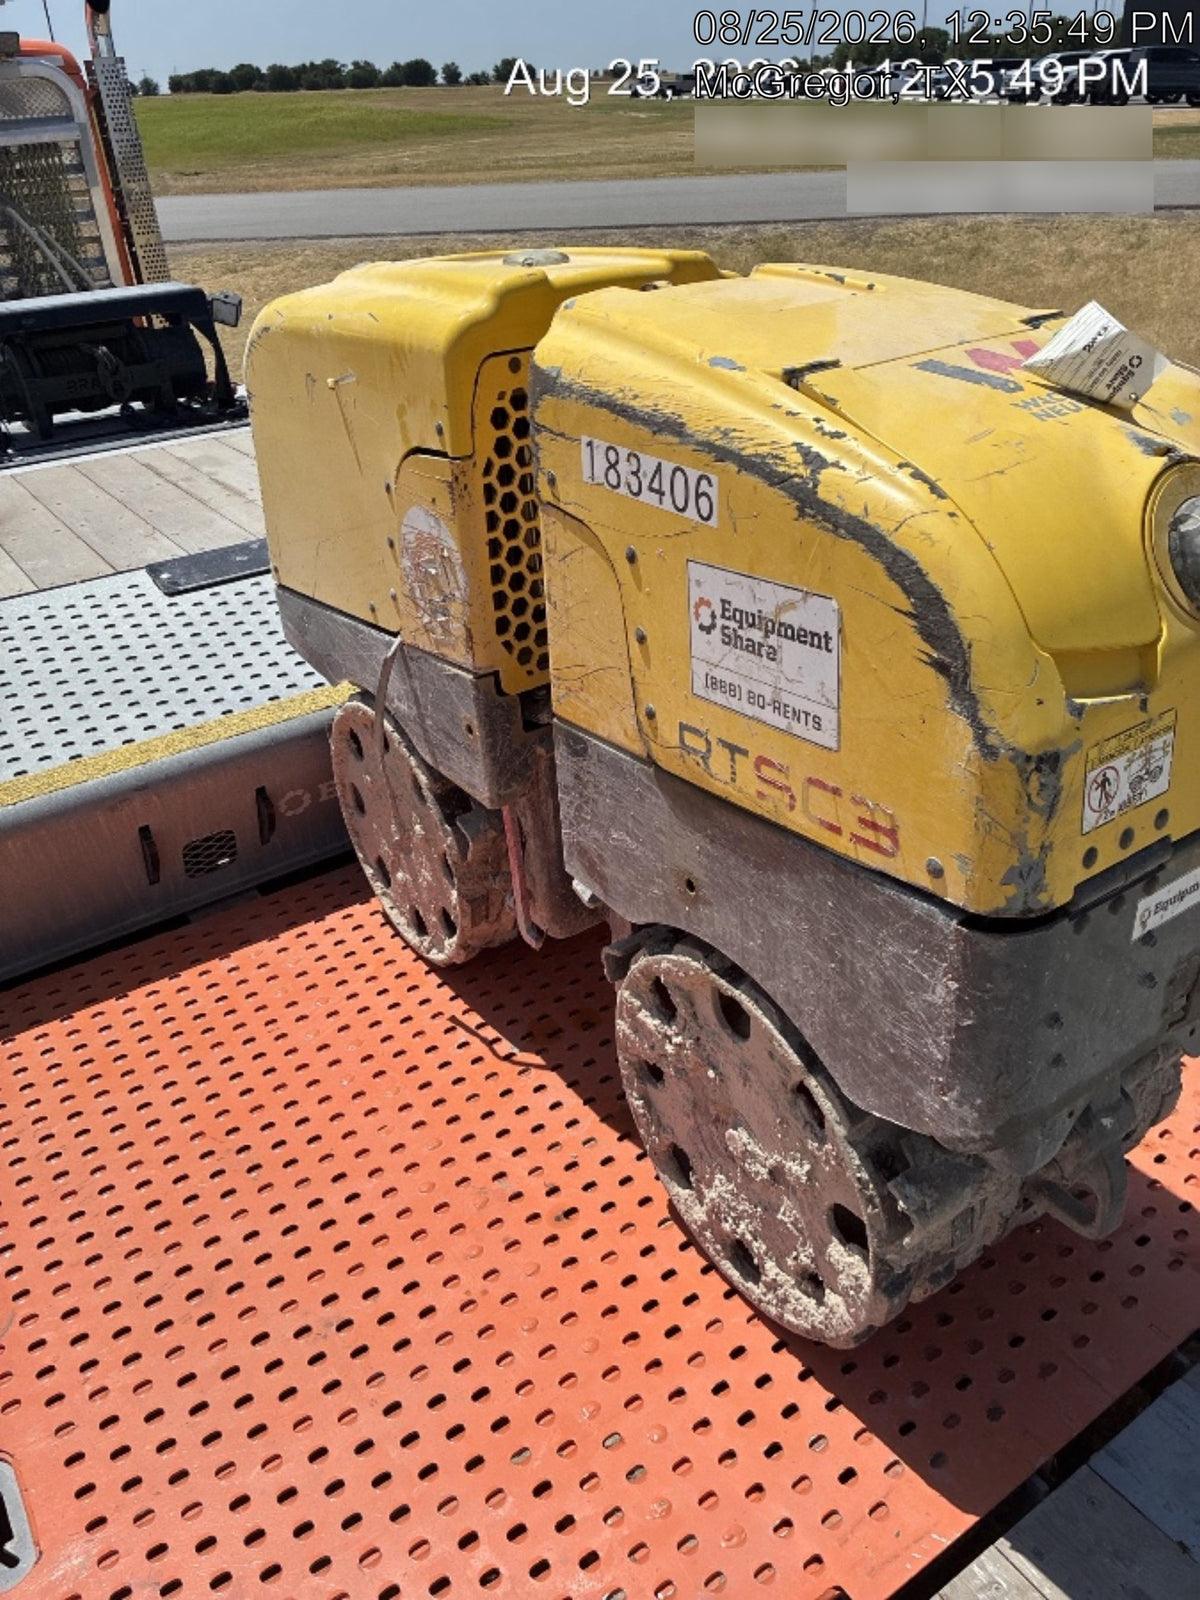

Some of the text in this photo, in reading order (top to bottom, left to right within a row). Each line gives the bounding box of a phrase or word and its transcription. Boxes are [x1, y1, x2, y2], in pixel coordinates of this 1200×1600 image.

[586, 439, 713, 522] 183406
[720, 598, 833, 653] Equipment
[720, 624, 777, 662] Share
[747, 689, 823, 731] 80-RENTS
